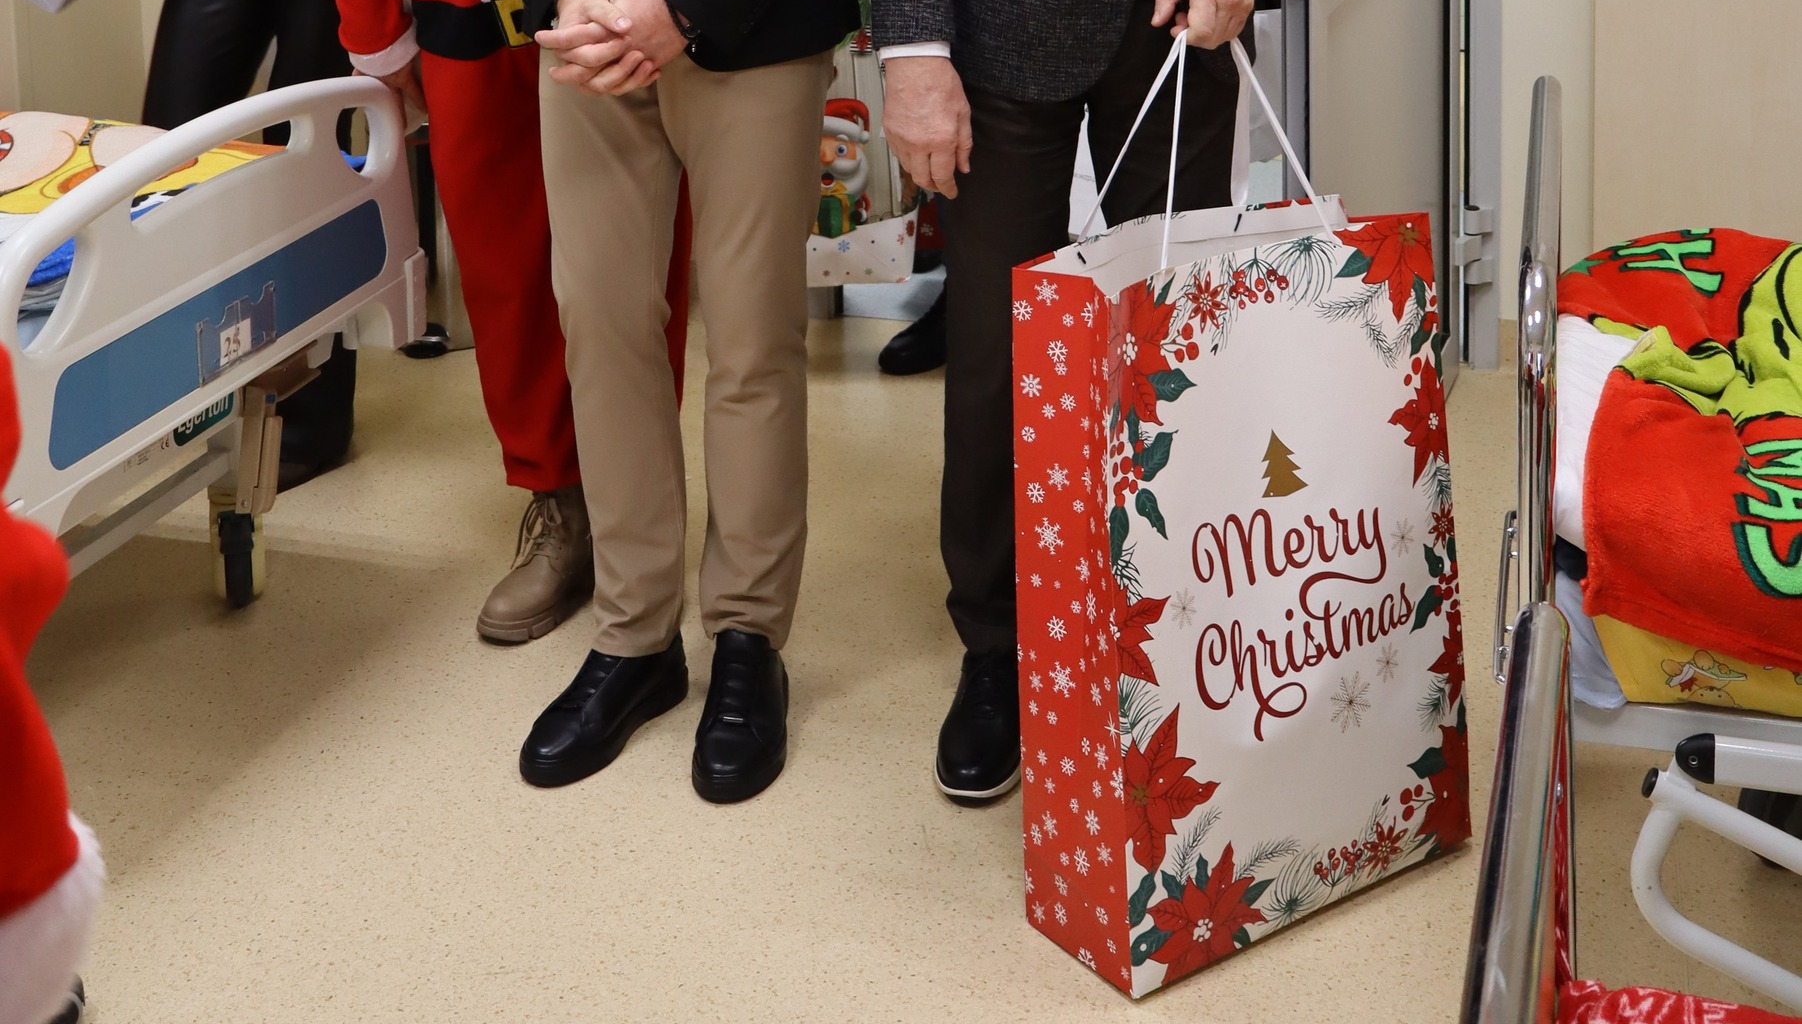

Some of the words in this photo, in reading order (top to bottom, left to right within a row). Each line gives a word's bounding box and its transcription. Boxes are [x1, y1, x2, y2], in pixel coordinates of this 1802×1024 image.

[224, 326, 241, 358] 25
[1192, 506, 1387, 598] Merry
[1194, 581, 1415, 742] Christmas
